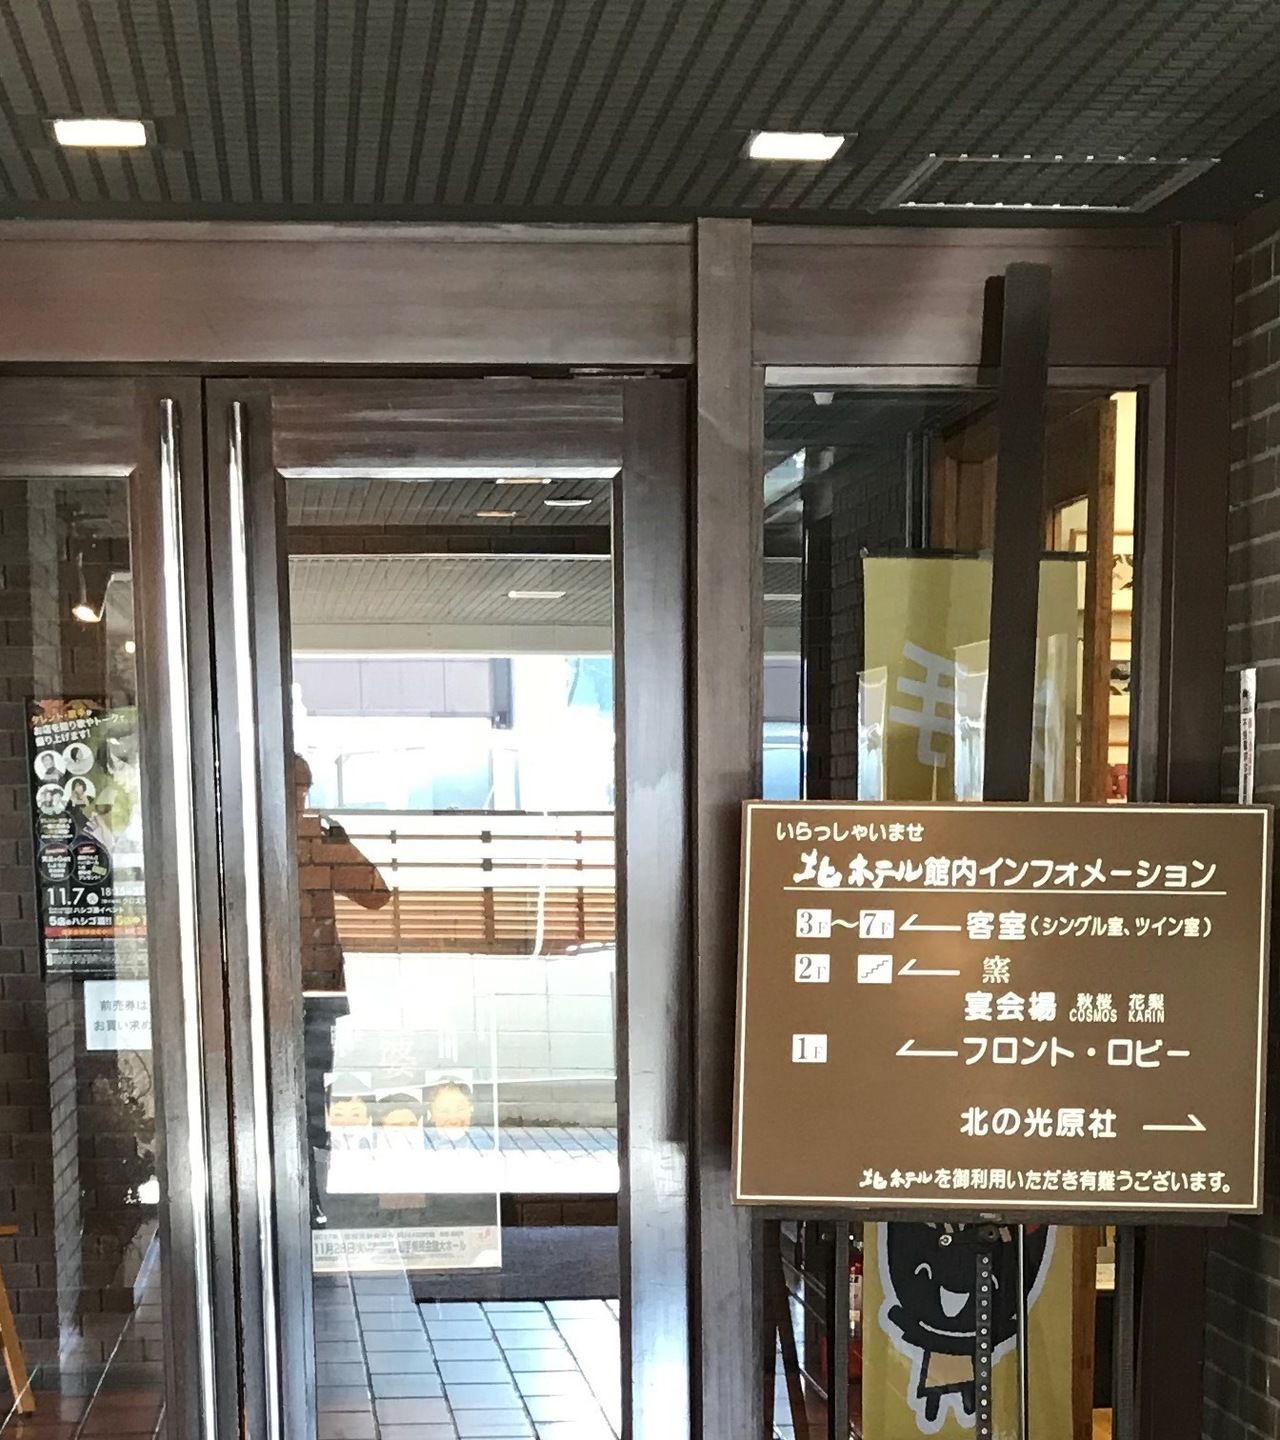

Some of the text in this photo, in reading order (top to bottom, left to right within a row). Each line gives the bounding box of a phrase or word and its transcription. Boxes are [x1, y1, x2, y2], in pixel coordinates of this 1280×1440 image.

[776, 822, 924, 842] いらっしゃいませ
[797, 956, 827, 980] 2F
[964, 991, 1165, 1022] 宴会場 秋桜 花梨
[1069, 1008, 1165, 1023] COSMOS KARIN
[797, 1036, 1191, 1068] 1F フロント・ロビー
[960, 1106, 1118, 1139] 北の光原社
